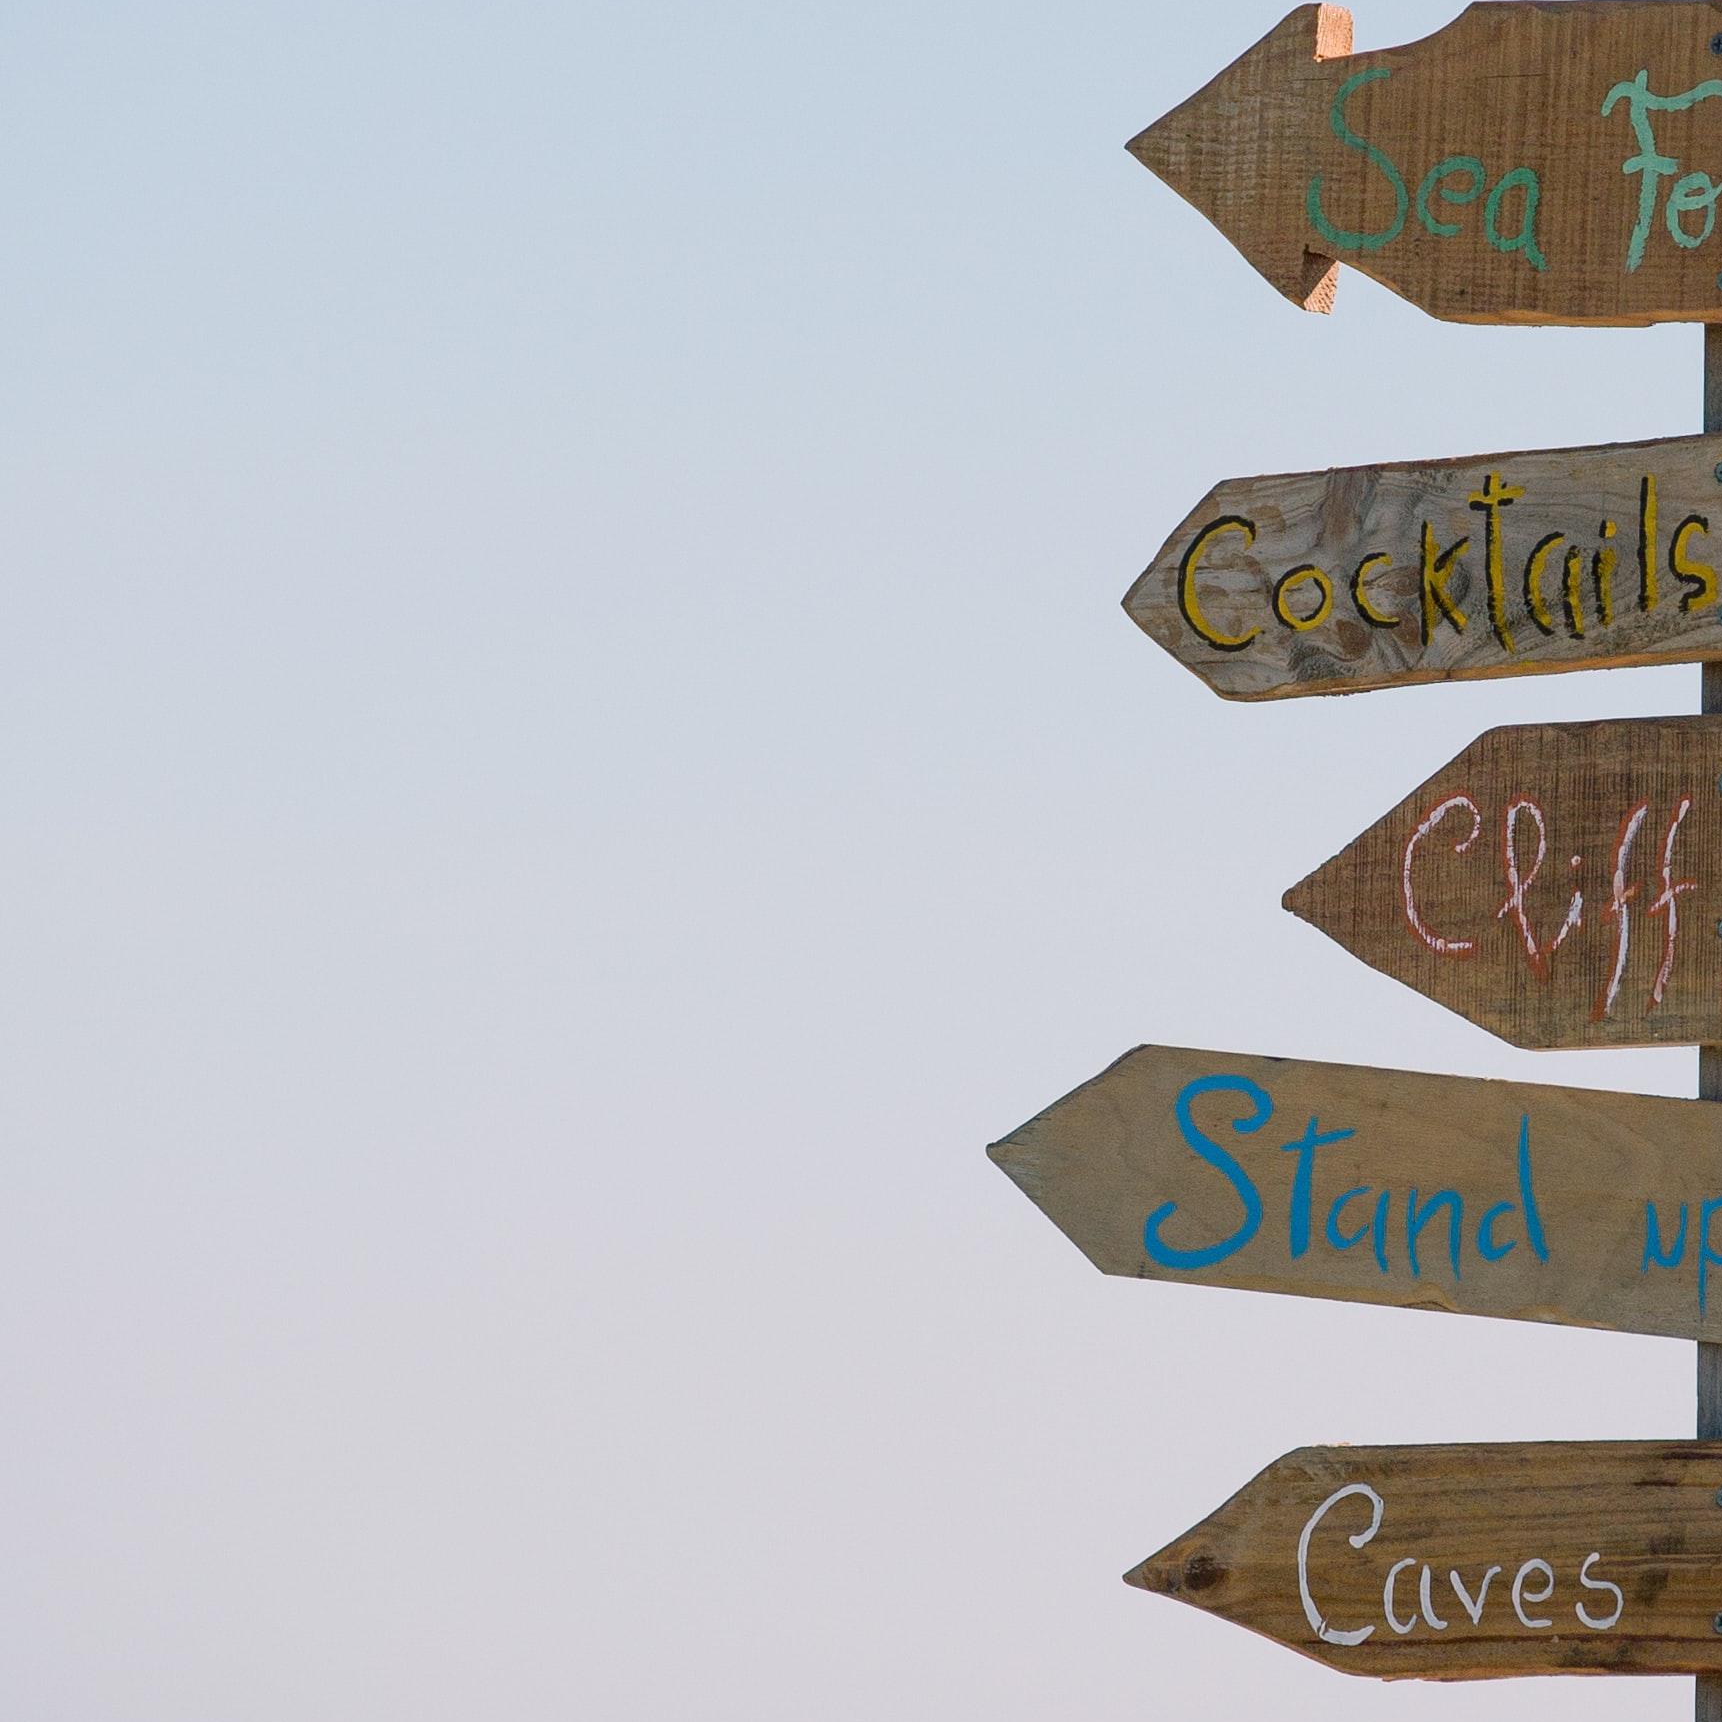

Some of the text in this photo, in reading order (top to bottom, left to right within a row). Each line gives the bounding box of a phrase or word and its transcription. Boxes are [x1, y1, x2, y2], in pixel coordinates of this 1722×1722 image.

[1307, 68, 1546, 271] Sea
[1177, 470, 1722, 653] Cocktails
[1402, 791, 1697, 1022] Cliff
[1144, 1073, 1550, 1271] Stand
[1297, 1482, 1624, 1645] Caves
